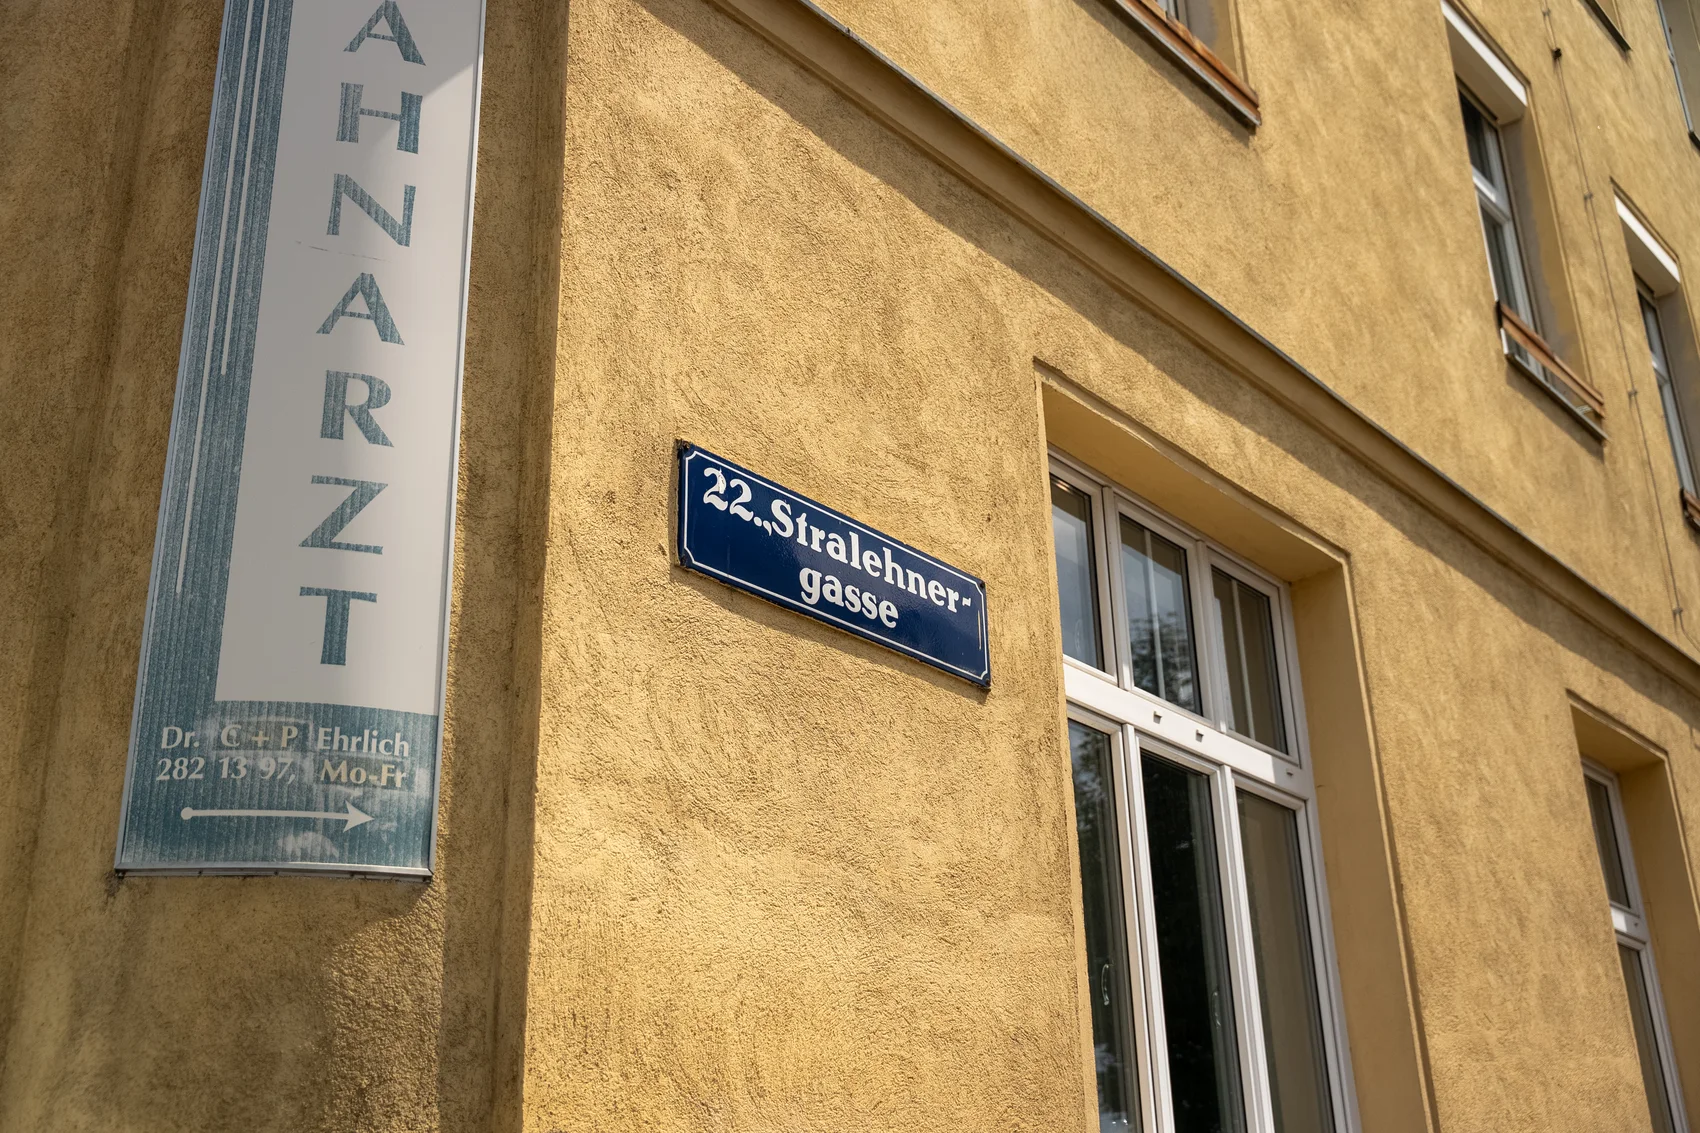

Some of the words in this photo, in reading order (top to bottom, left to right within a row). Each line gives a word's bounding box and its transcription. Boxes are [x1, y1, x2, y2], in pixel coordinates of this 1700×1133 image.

[770, 499, 972, 613] Stralehner-
[799, 567, 899, 629] gasse
[161, 726, 199, 749] Dr.
[281, 726, 298, 748] P
[317, 727, 410, 757] Ehrlich
[156, 757, 205, 782] 282
[219, 757, 248, 780] 13
[259, 757, 296, 785] 97,
[320, 760, 406, 787] Mo-Fr
